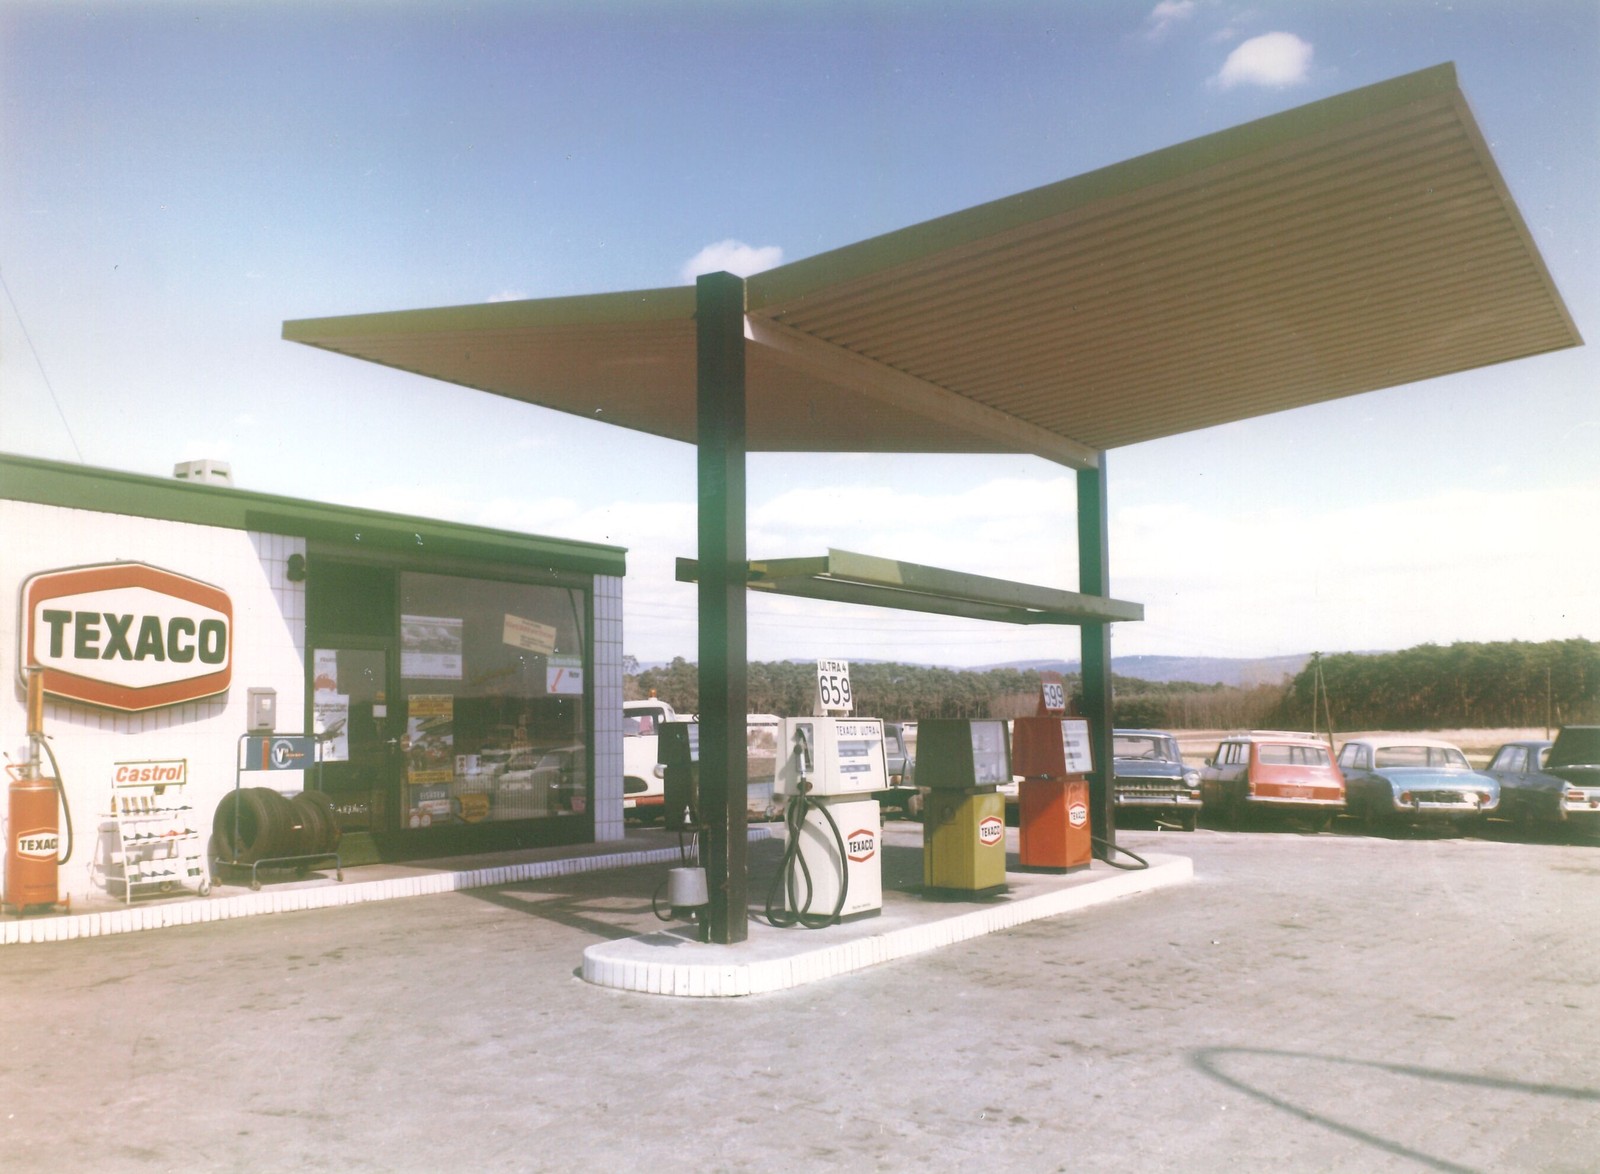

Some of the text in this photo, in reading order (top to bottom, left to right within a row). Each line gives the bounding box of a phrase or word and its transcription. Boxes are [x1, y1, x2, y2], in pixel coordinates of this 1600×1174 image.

[42, 609, 227, 664] TEXACO
[819, 661, 847, 673] ULTRA 4
[836, 725, 857, 736] TEXACO
[116, 764, 183, 783] Castrol
[1070, 810, 1086, 820] TEXACO
[981, 825, 1001, 837] TEXACO
[20, 838, 58, 851] TEXAC
[849, 839, 874, 853] TEXACO
